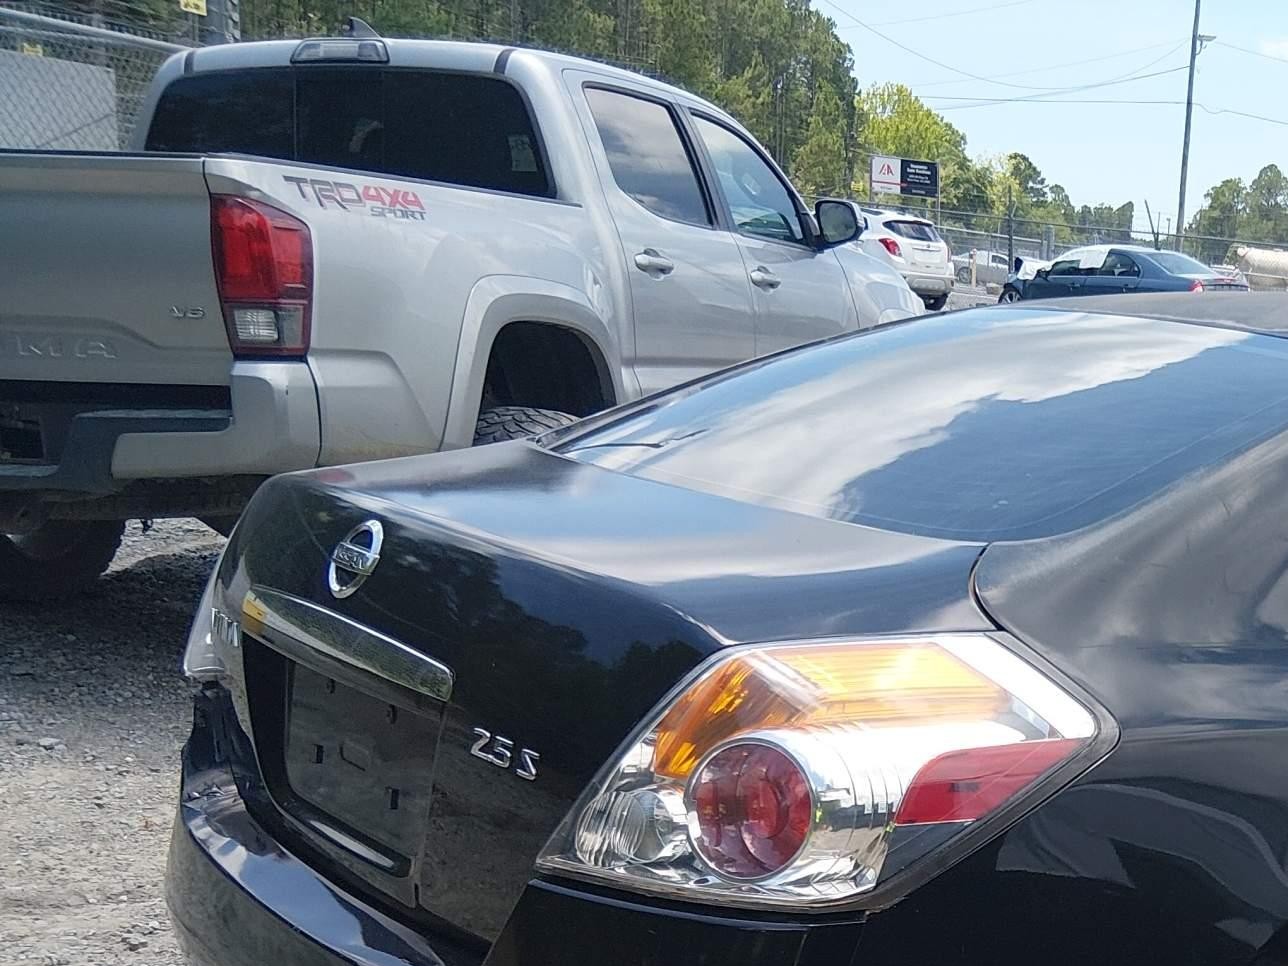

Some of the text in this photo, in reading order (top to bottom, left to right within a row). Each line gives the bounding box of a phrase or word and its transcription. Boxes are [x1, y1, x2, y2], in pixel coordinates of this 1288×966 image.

[282, 175, 366, 210] TRD
[370, 206, 427, 221] SPORT
[516, 748, 541, 781] S
